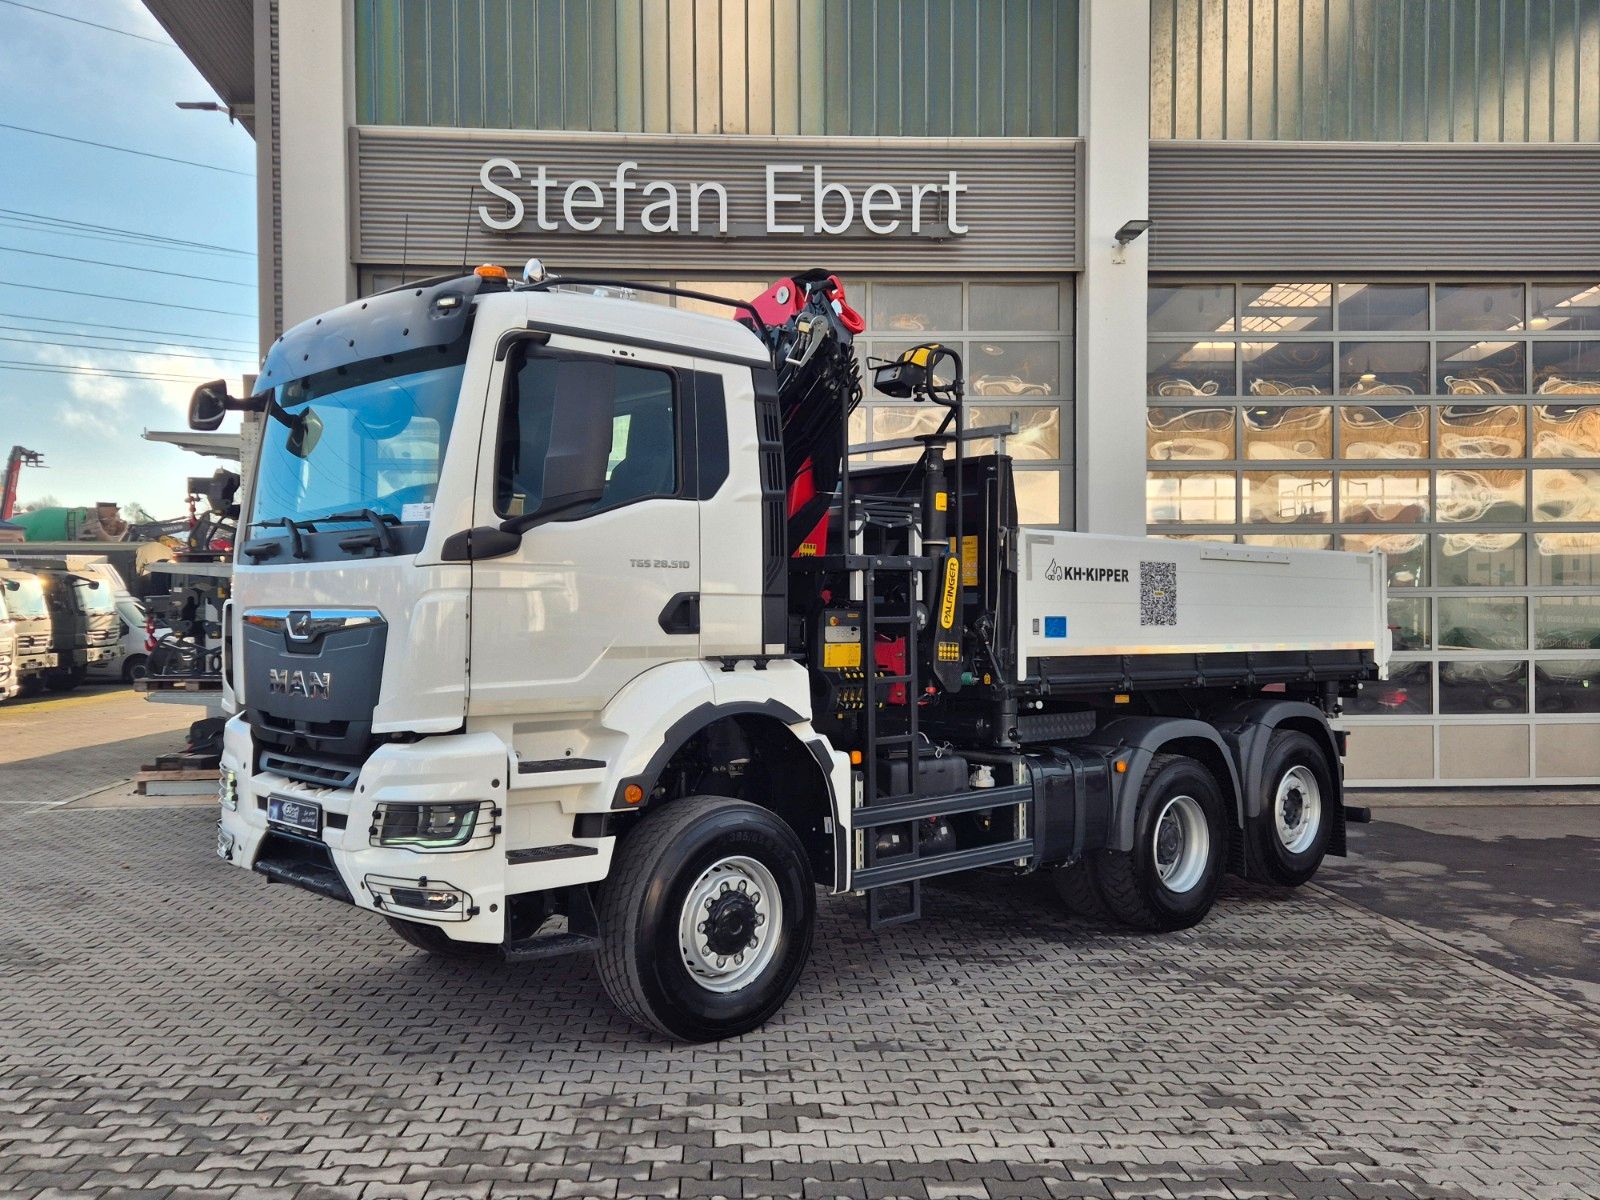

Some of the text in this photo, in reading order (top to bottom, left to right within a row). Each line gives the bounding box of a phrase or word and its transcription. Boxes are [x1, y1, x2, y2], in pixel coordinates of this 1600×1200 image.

[478, 157, 968, 236] Stefan Ebert
[653, 559, 690, 569] 28.510
[1064, 566, 1129, 583] KH-KIPPER
[943, 562, 957, 624] PALFINGER
[269, 668, 331, 700] MAN
